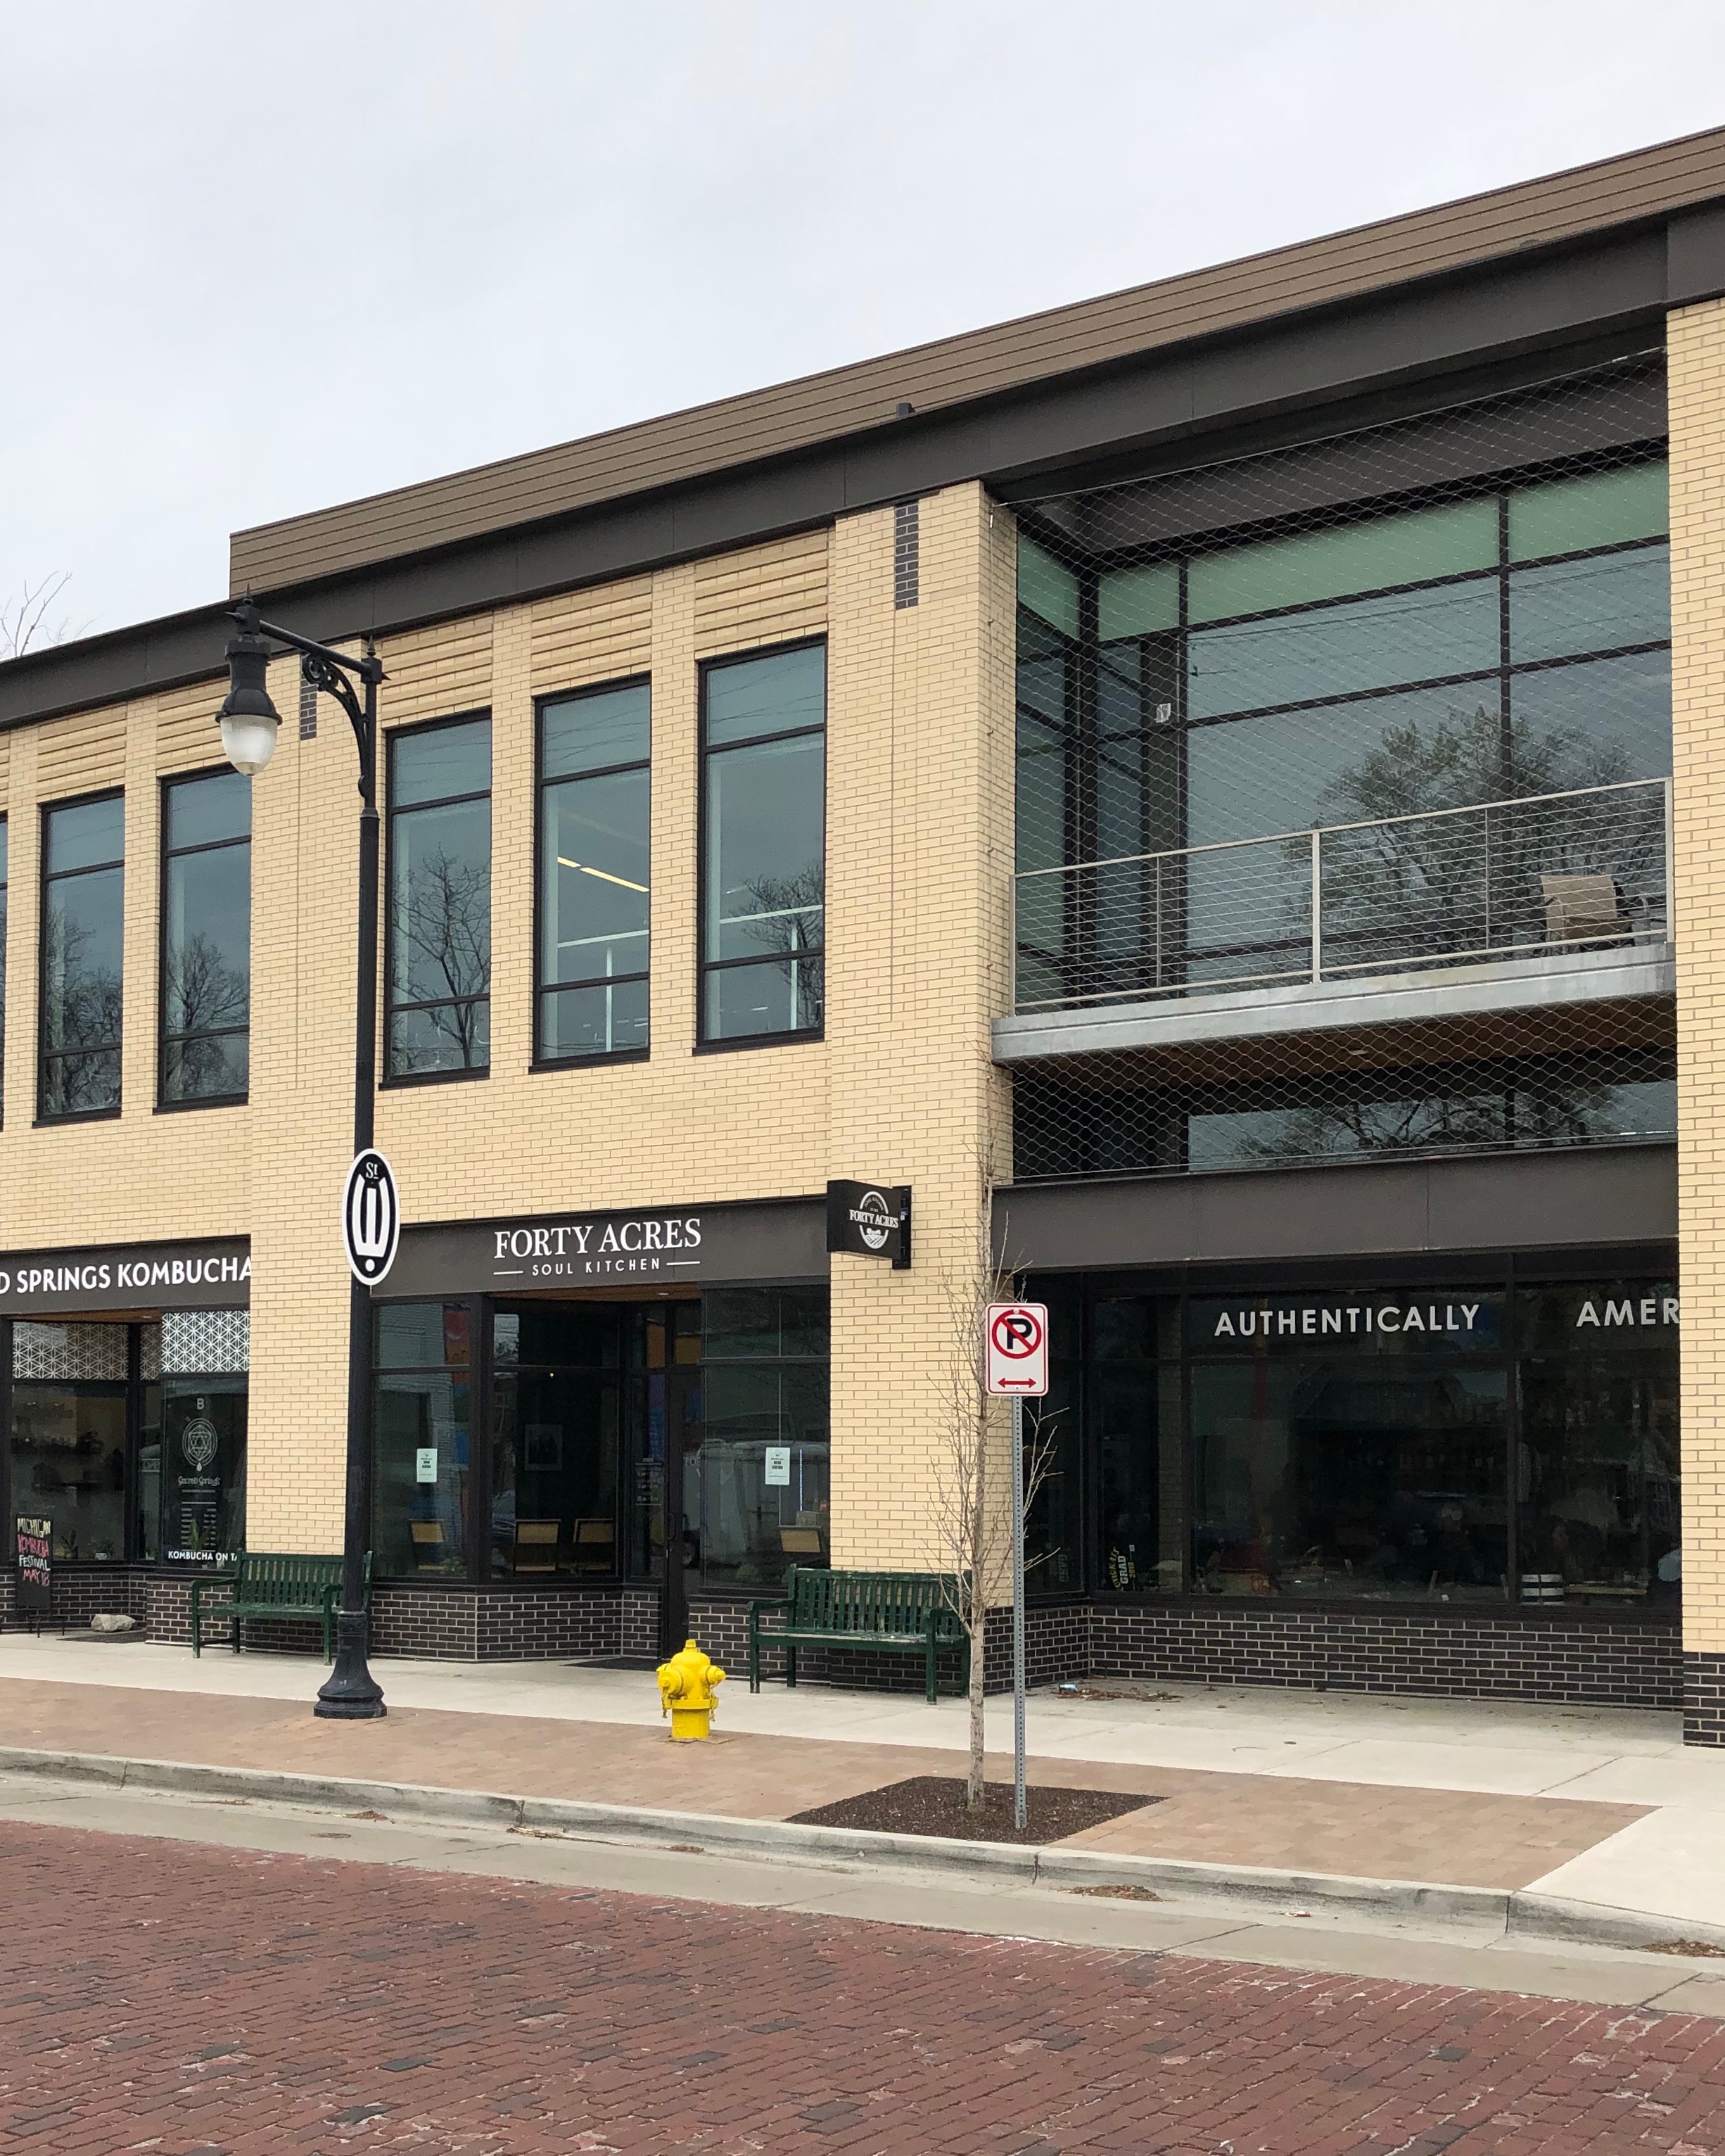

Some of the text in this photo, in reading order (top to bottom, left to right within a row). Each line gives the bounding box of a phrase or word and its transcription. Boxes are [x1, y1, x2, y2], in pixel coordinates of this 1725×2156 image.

[848, 1209, 899, 1229] FORTY ACRES
[494, 1218, 701, 1259] FORTY ACRES
[16, 1264, 110, 1294] SPRINGS
[117, 1256, 252, 1288] KOMBUCHA
[532, 1257, 660, 1276] SOUL KITCHEN
[1214, 1298, 1680, 1337] AUTHENTICALLY AMER
[17, 1518, 51, 1538] MICHIGAN
[18, 1554, 51, 1571] FESTIVAL
[168, 1550, 213, 1561] KOMBUCHA
[215, 1552, 229, 1561] ON
[23, 1568, 41, 1584] MAY
[1117, 1555, 1129, 1584] GRAD
